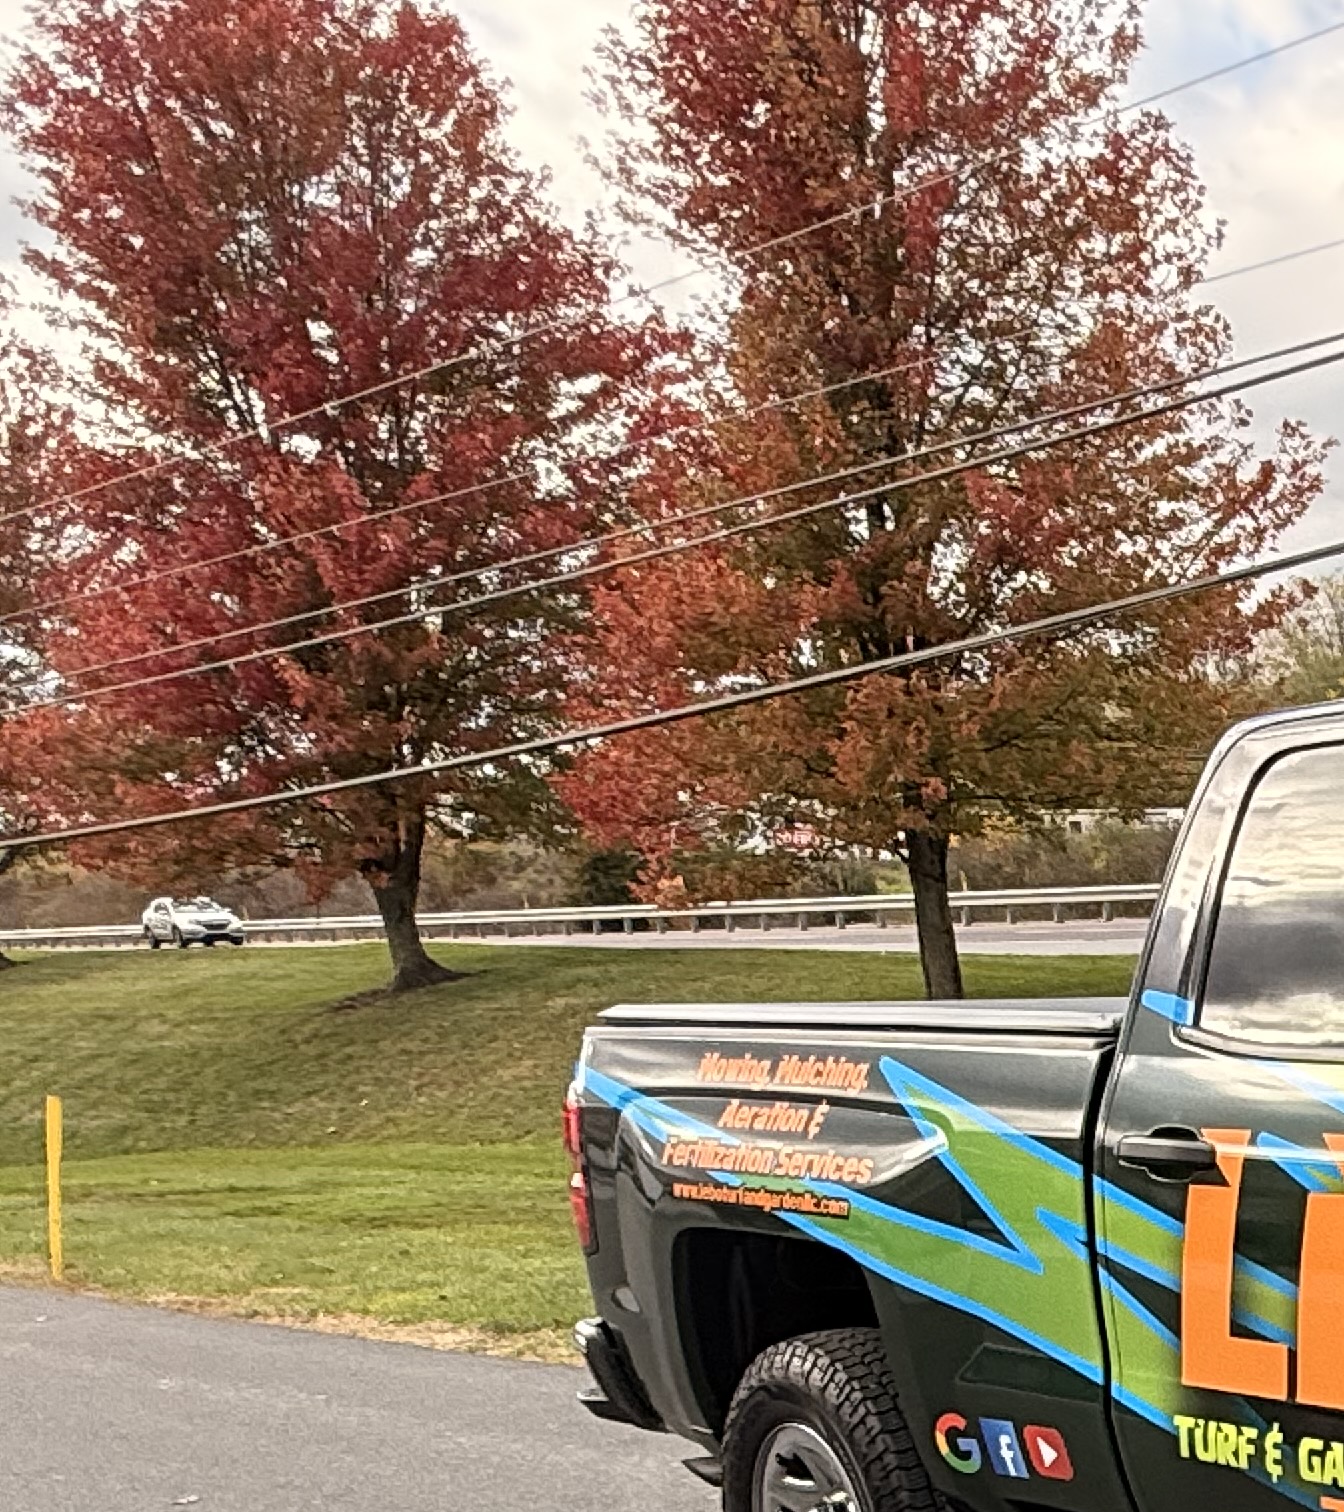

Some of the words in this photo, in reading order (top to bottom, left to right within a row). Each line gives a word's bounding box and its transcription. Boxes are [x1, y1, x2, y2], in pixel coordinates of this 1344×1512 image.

[717, 1099, 810, 1132] Aeration
[808, 1099, 830, 1139] &
[661, 1137, 773, 1173] Fertilization
[774, 1146, 874, 1184] Services
[1173, 1414, 1256, 1471] TURF
[1263, 1422, 1284, 1483] &
